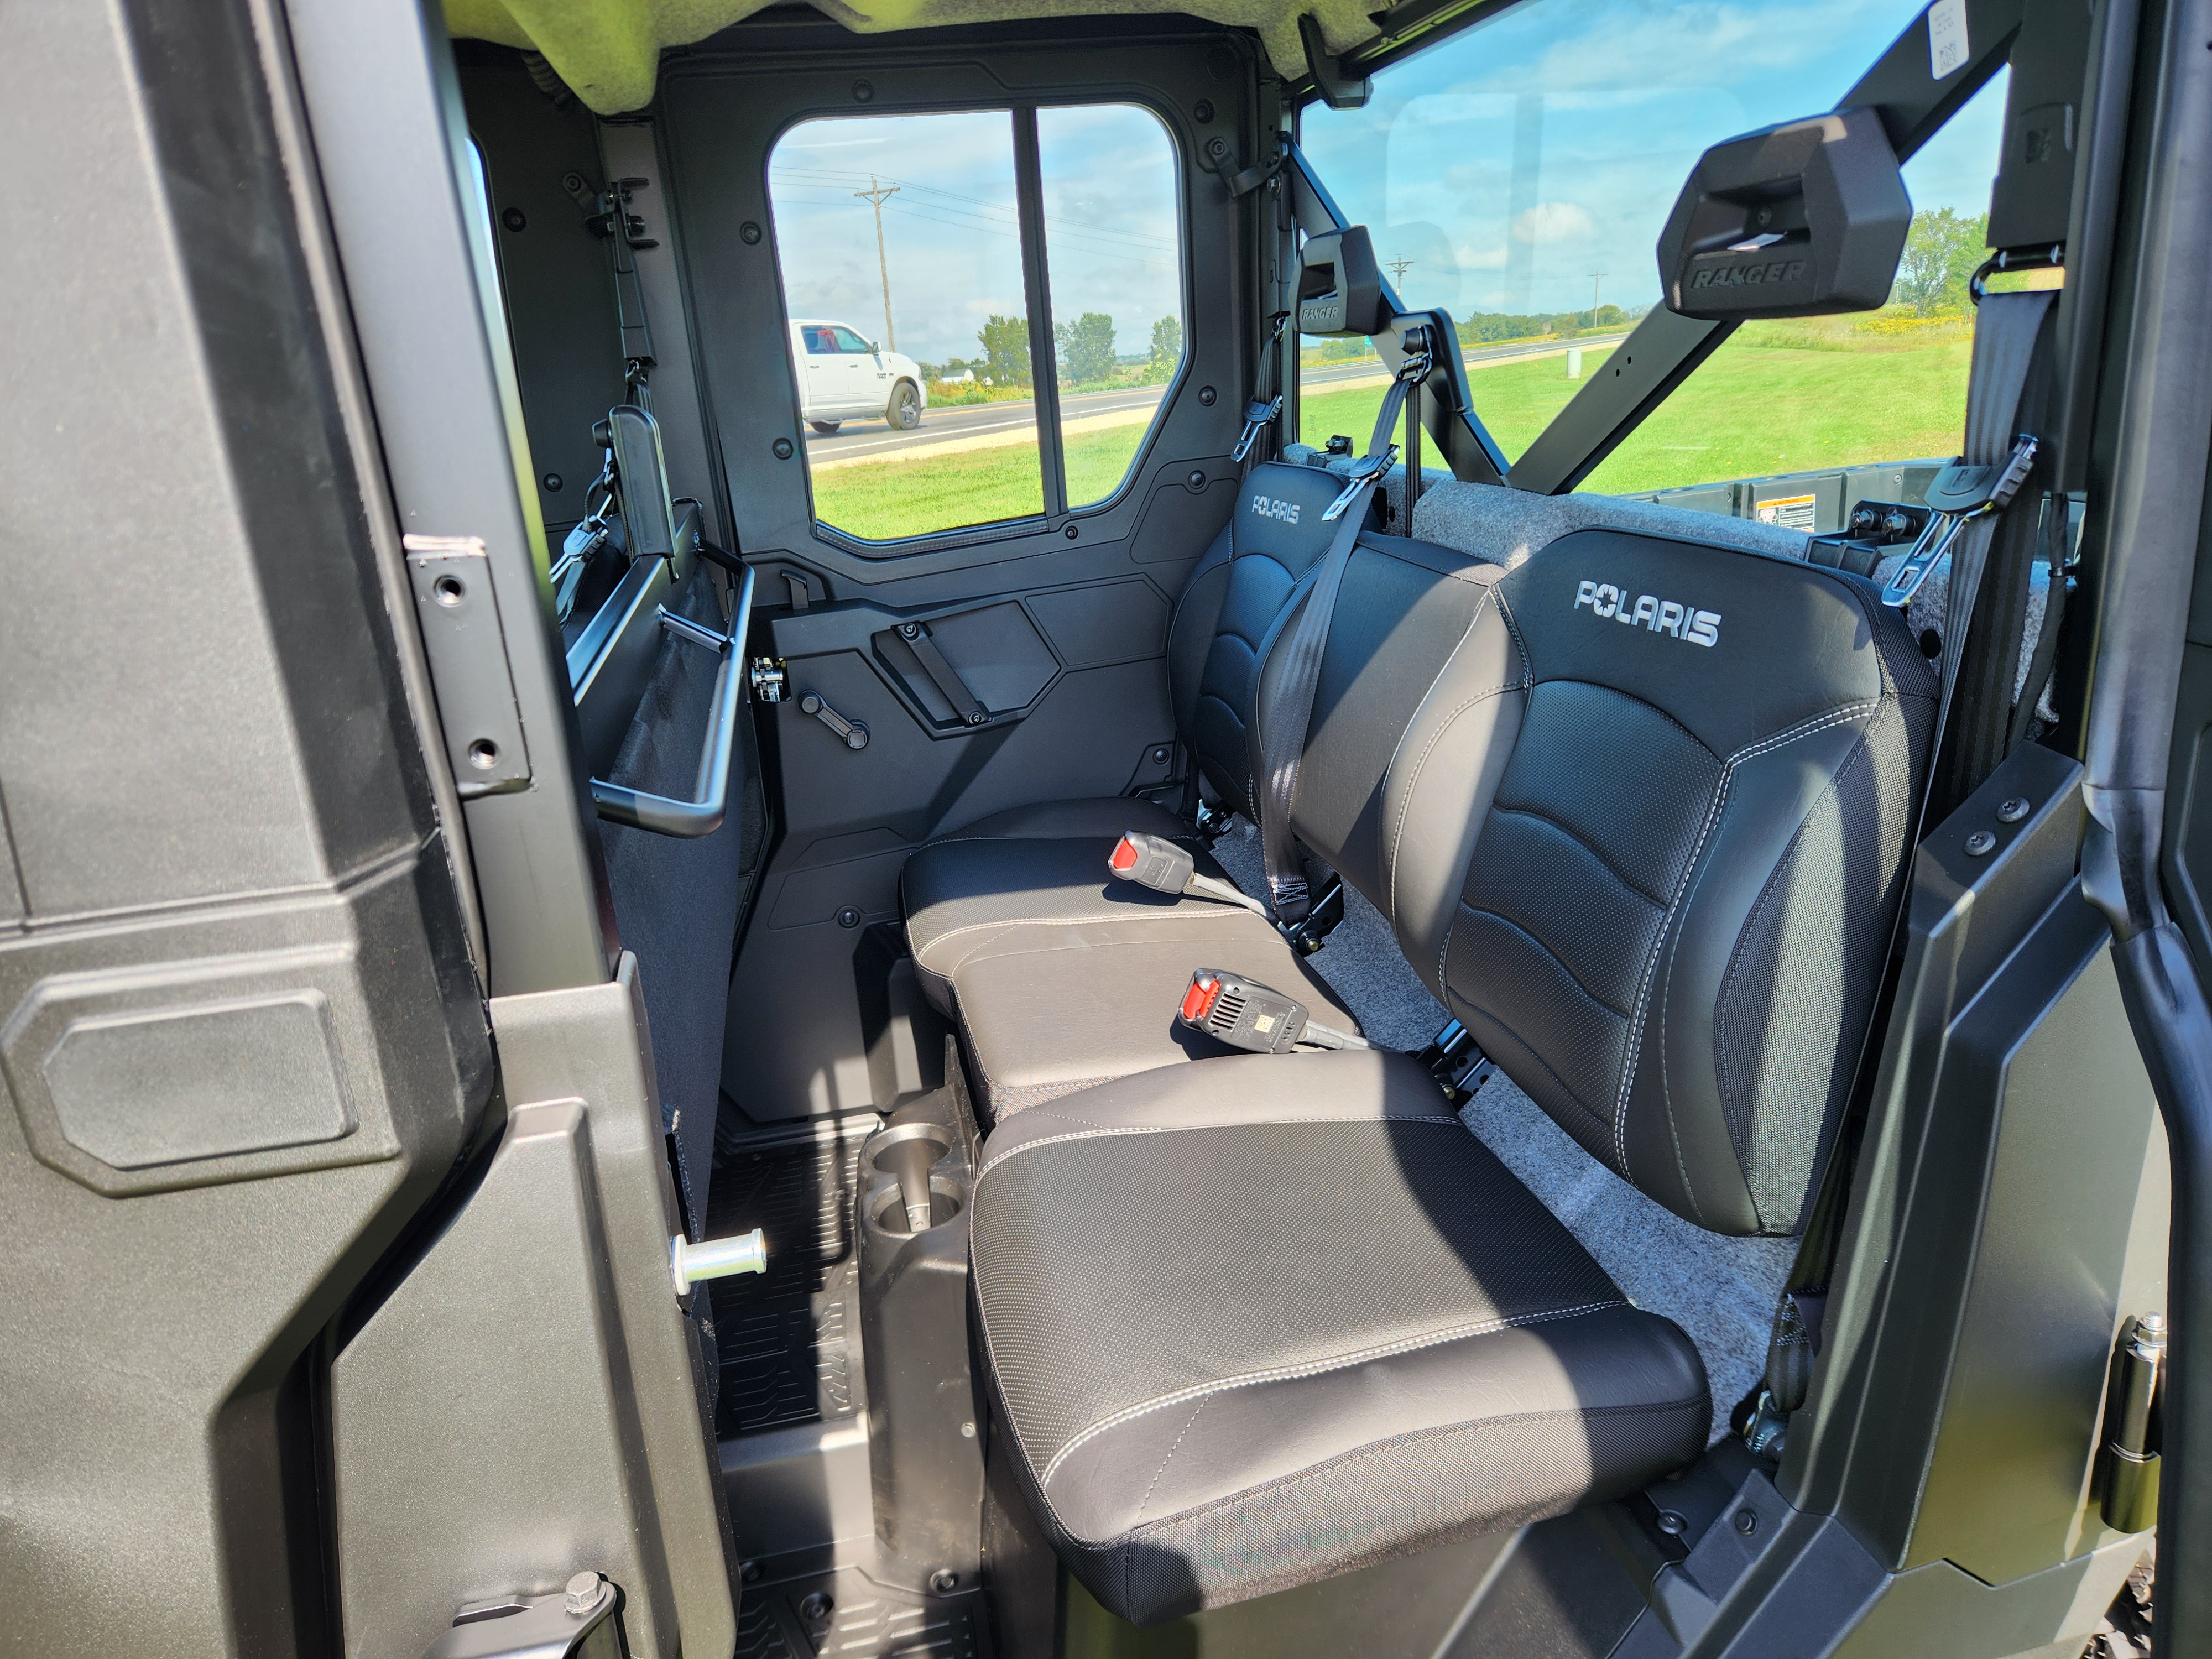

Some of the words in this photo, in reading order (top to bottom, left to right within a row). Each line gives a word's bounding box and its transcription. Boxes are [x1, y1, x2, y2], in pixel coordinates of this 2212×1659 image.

[1691, 260, 1806, 288] RANGER
[1302, 306, 1338, 320] RANGER
[1251, 495, 1301, 524] POLARIS
[1573, 580, 1721, 648] POLARIS
